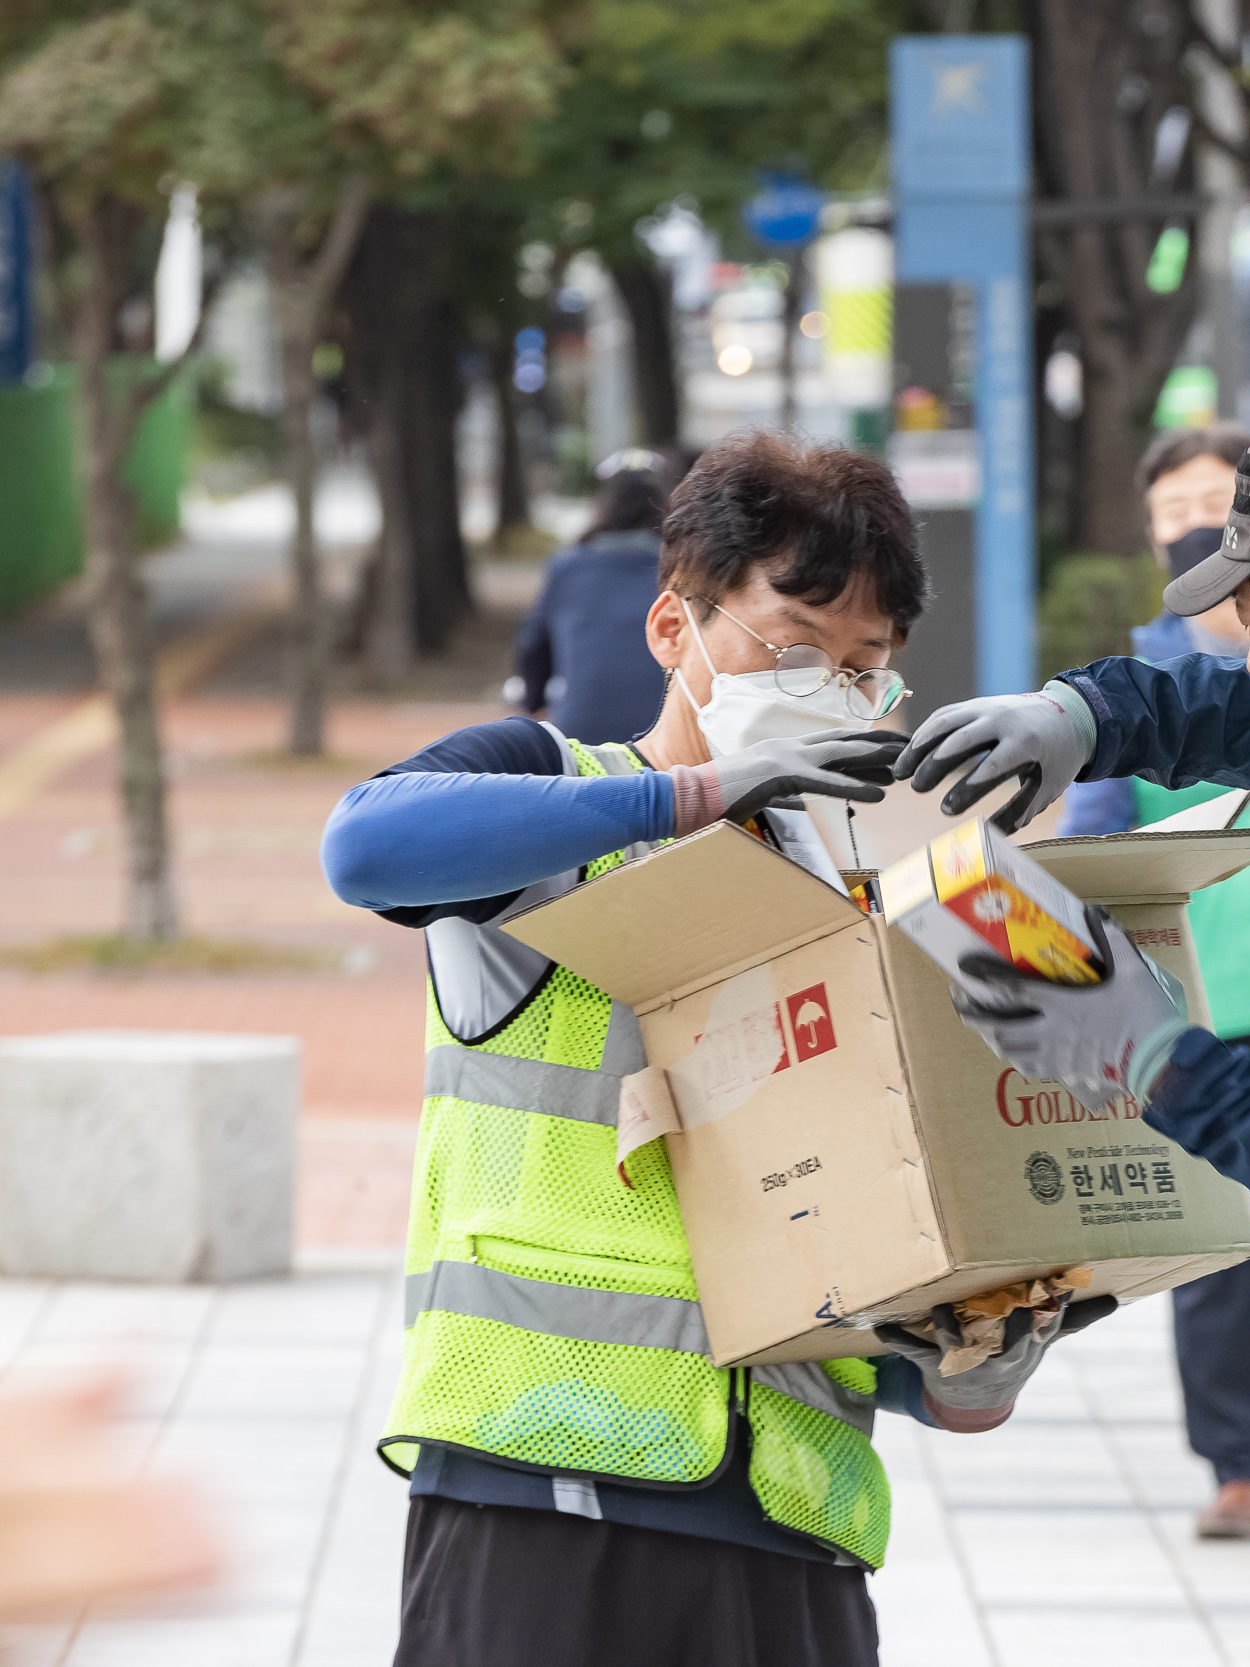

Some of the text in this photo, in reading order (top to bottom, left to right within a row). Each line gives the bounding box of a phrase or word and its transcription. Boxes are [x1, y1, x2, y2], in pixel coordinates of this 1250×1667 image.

[1066, 1147, 1085, 1160] New
[1123, 1143, 1170, 1158] Technology
[1069, 1161, 1176, 1197] 한세약품
